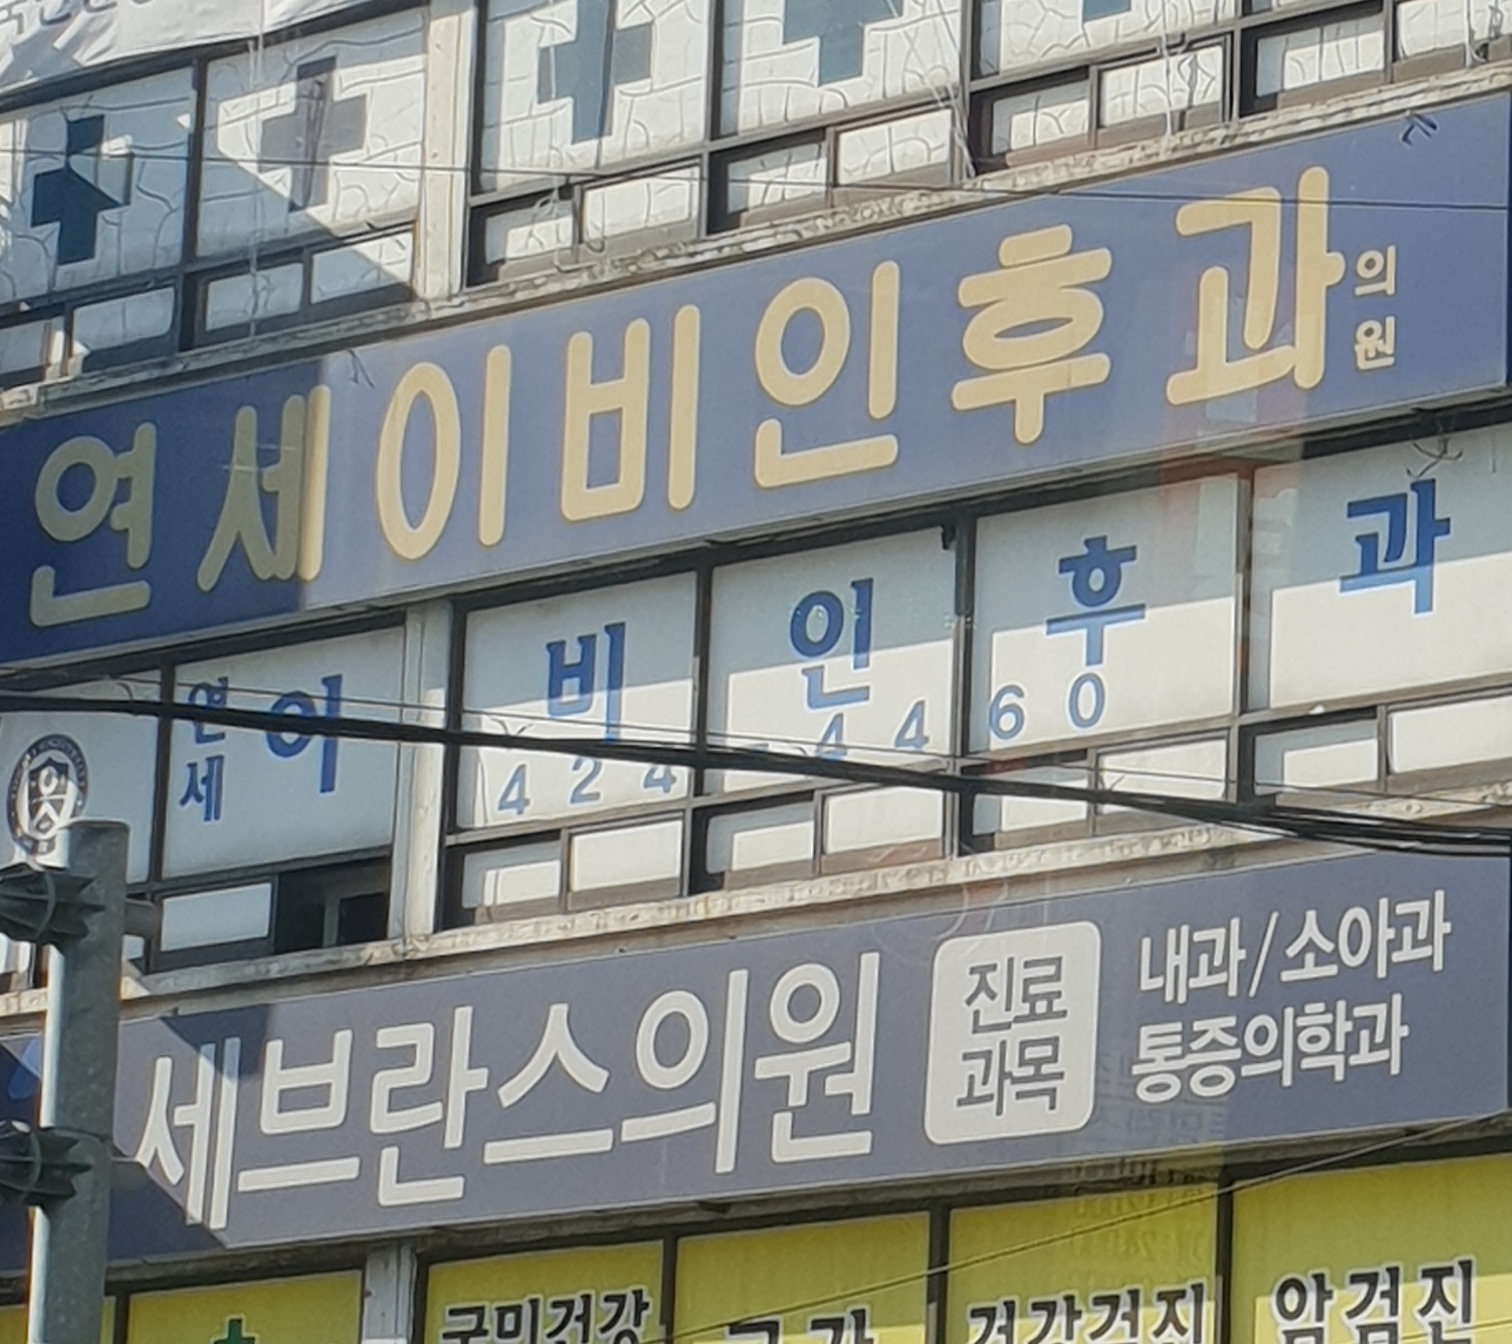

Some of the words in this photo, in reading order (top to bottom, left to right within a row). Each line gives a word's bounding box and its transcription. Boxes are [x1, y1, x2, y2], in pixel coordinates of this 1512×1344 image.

[1355, 244, 1397, 372] 의원
[964, 955, 1068, 1036] 진료
[1139, 888, 1452, 1004] 내과/소아과
[135, 952, 880, 1231] 세브란스의원
[955, 1034, 1066, 1117] 과목
[1130, 993, 1410, 1104] 통증의학과
